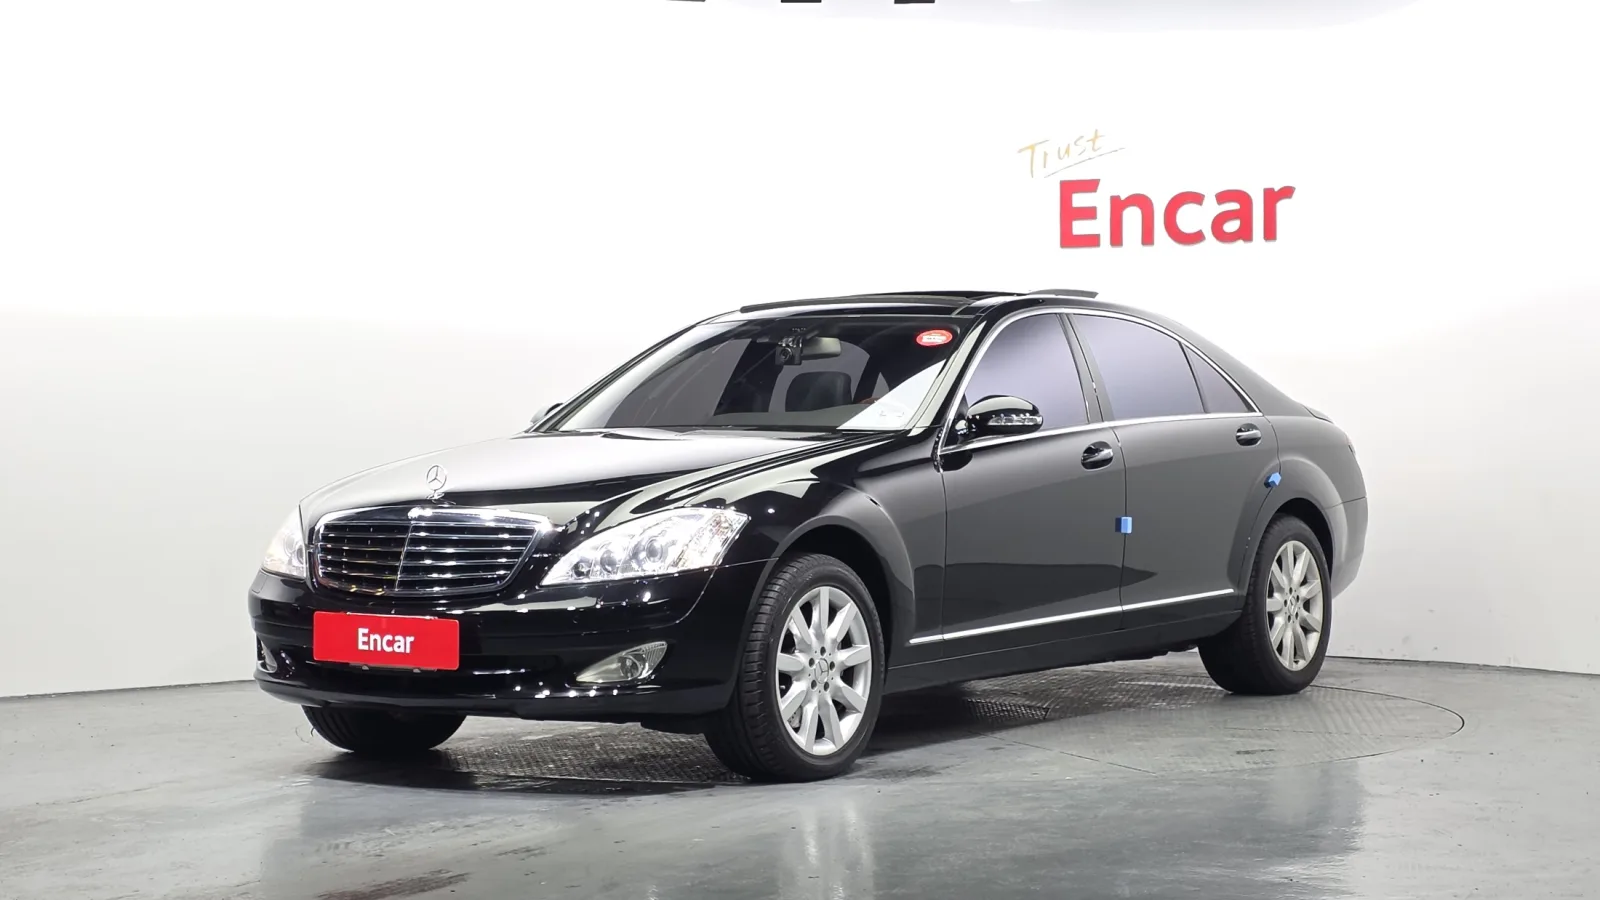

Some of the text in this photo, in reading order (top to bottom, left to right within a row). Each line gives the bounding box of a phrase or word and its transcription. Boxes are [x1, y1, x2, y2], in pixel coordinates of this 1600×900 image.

[1017, 129, 1104, 178] Trust
[1060, 178, 1296, 248] Encar
[357, 627, 414, 654] Encar
